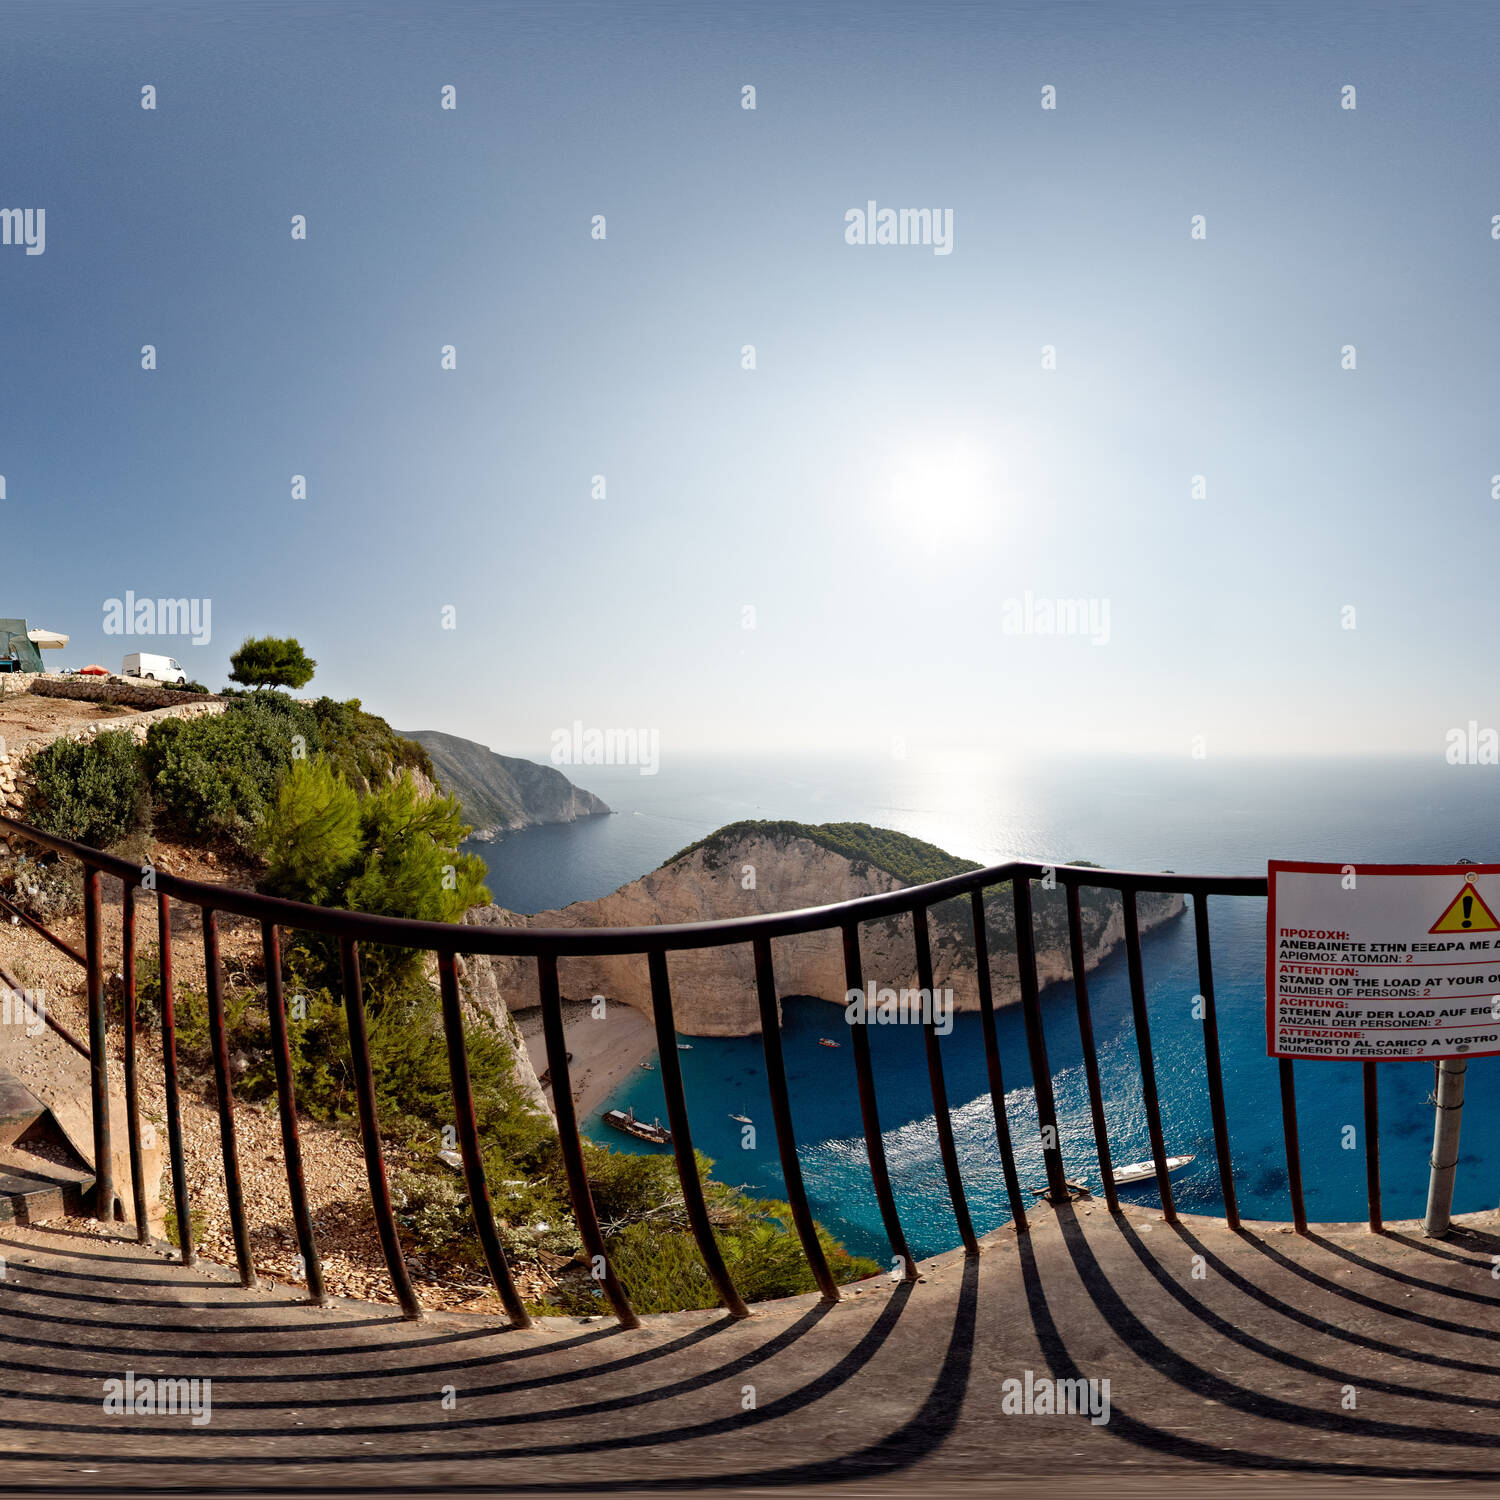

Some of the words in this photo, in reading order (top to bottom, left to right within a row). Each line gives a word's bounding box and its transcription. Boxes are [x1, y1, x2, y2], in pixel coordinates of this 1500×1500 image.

[1280, 928, 1349, 940] ΠΡΟΣΟΧΗ:
[1280, 940, 1366, 951] ΑΝΕΒΑΙΝΕΤΕ
[1412, 942, 1464, 952] ΕΞΕΔΡΑ
[1470, 941, 1490, 950] ΜΕ
[1280, 951, 1337, 961] ΑΡΙΘΜΟΣ
[1341, 954, 1401, 963] ΑΤΟΜΩΝ:
[1280, 965, 1358, 976] ATTENTION:
[1280, 976, 1324, 985] STAND
[1329, 978, 1348, 986] ON
[1425, 978, 1442, 986] AT
[1447, 976, 1484, 985] YOUR
[1280, 985, 1332, 995] NUMBER
[1280, 998, 1348, 1008] ACHTUNG:
[1280, 1008, 1330, 1017] STEHEN
[1440, 1008, 1467, 1017] AUF
[1280, 1017, 1327, 1026] ANZAHL
[1280, 1028, 1365, 1038] ATTENZIONE:
[1280, 1037, 1350, 1046] SUPPORTO
[1445, 1035, 1498, 1045] VOSTRO
[1279, 1045, 1332, 1054] NUMERO
